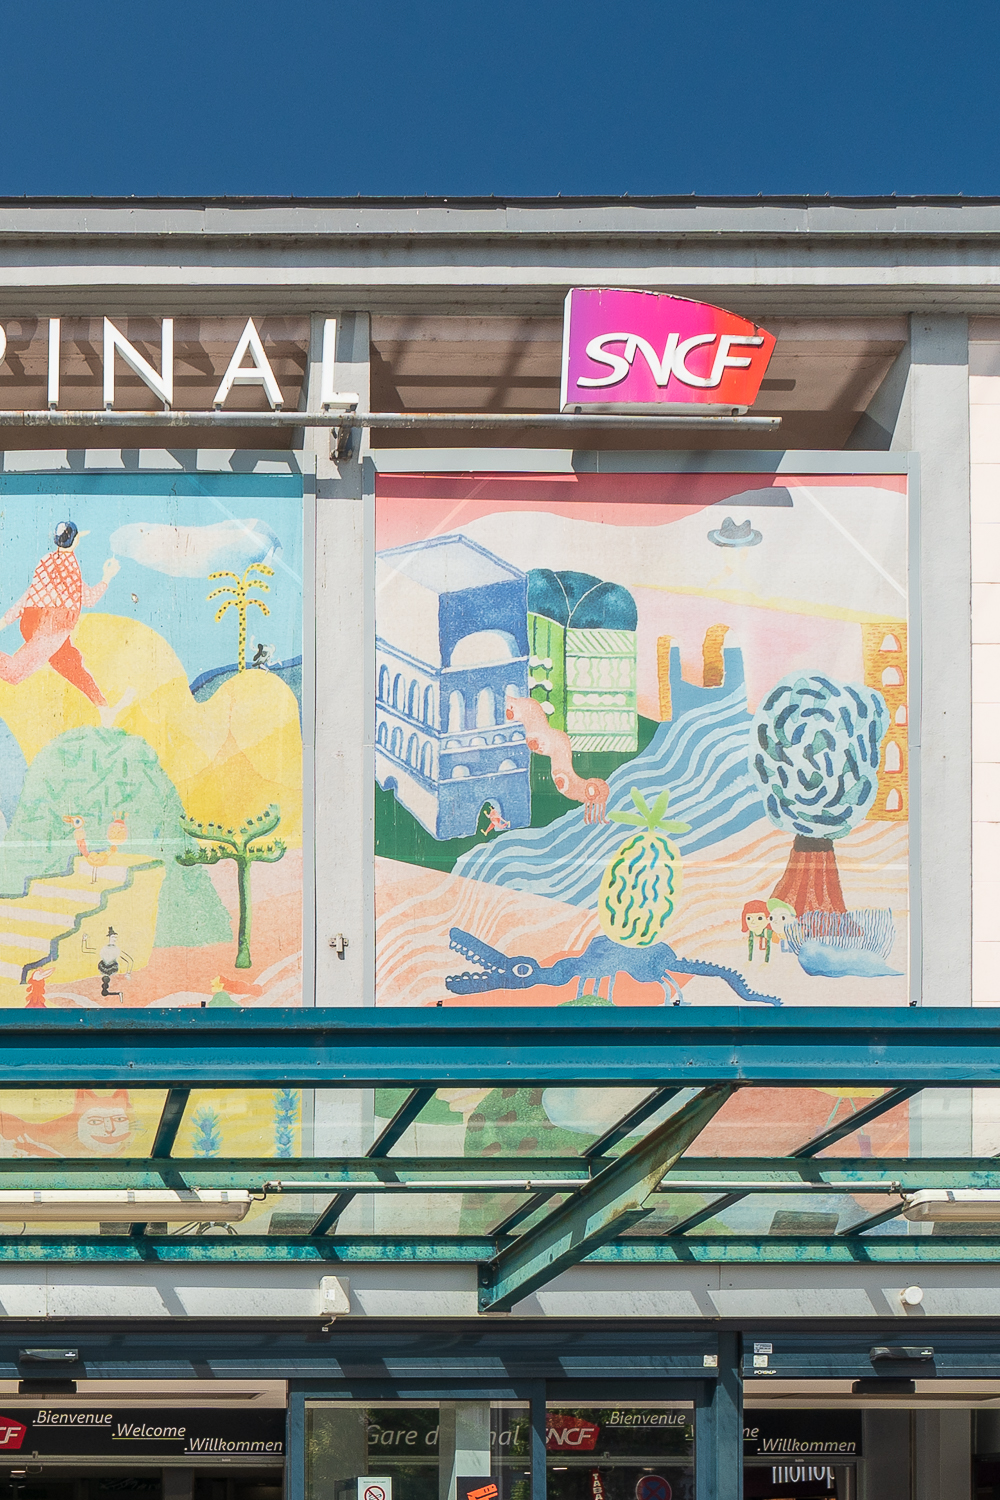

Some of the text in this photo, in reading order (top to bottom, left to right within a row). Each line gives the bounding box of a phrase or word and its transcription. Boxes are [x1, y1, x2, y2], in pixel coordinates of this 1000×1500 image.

[576, 332, 764, 390] SNCF
[367, 1424, 418, 1445] Gare
[546, 1427, 595, 1446] NCF
